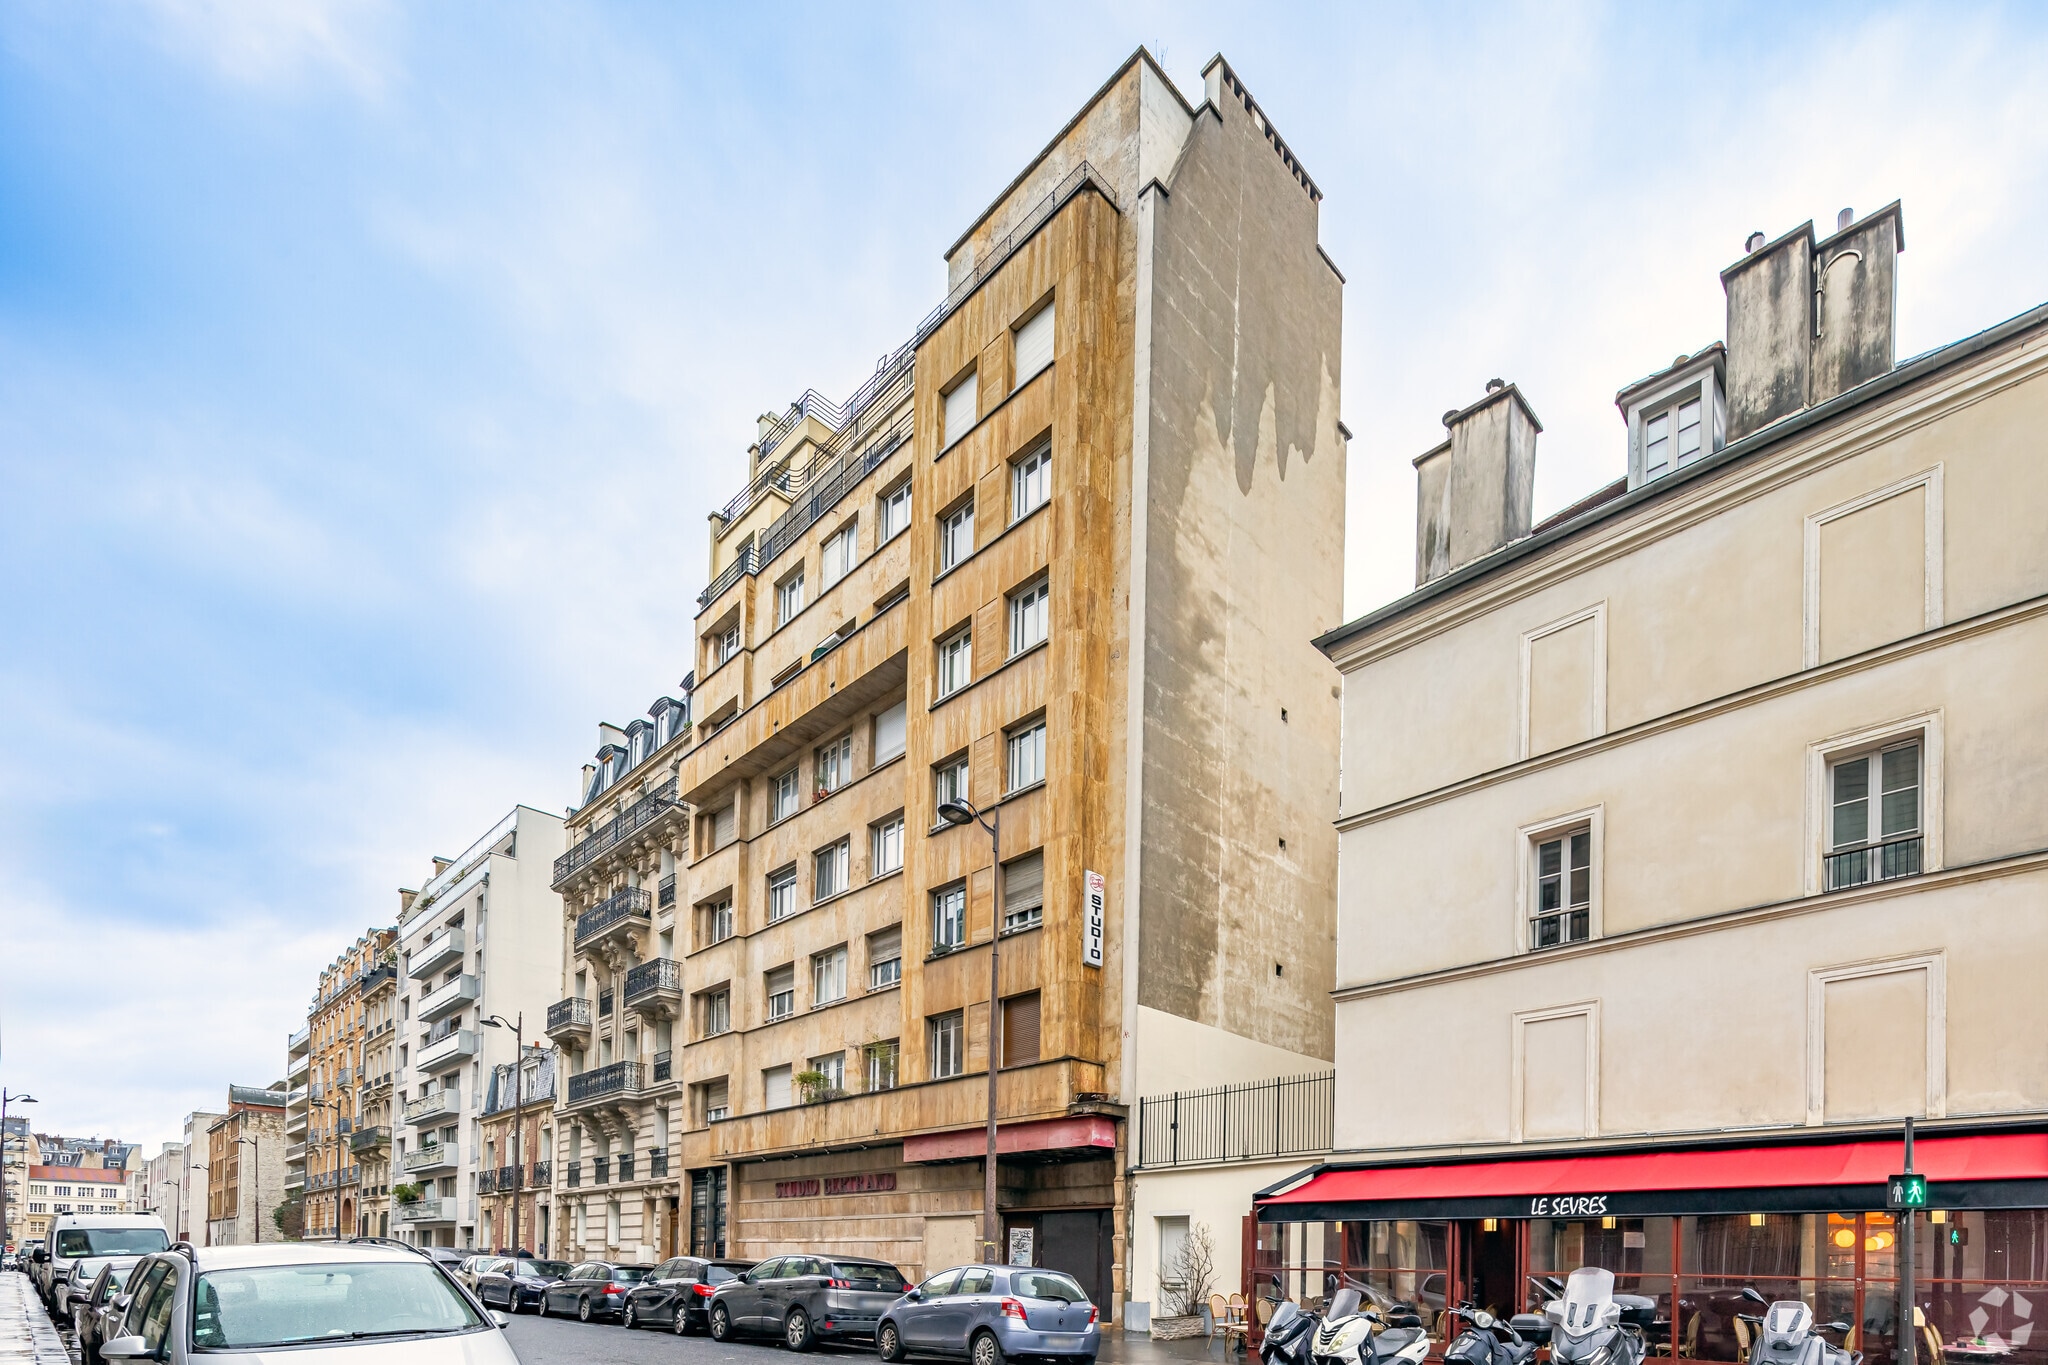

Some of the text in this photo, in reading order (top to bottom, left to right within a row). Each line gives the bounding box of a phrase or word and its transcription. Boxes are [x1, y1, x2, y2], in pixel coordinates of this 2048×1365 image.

[1091, 894, 1102, 960] STUDIO
[776, 1173, 897, 1198] STUDIO BERTRAND
[1531, 1195, 1608, 1216] LE SEVRES
